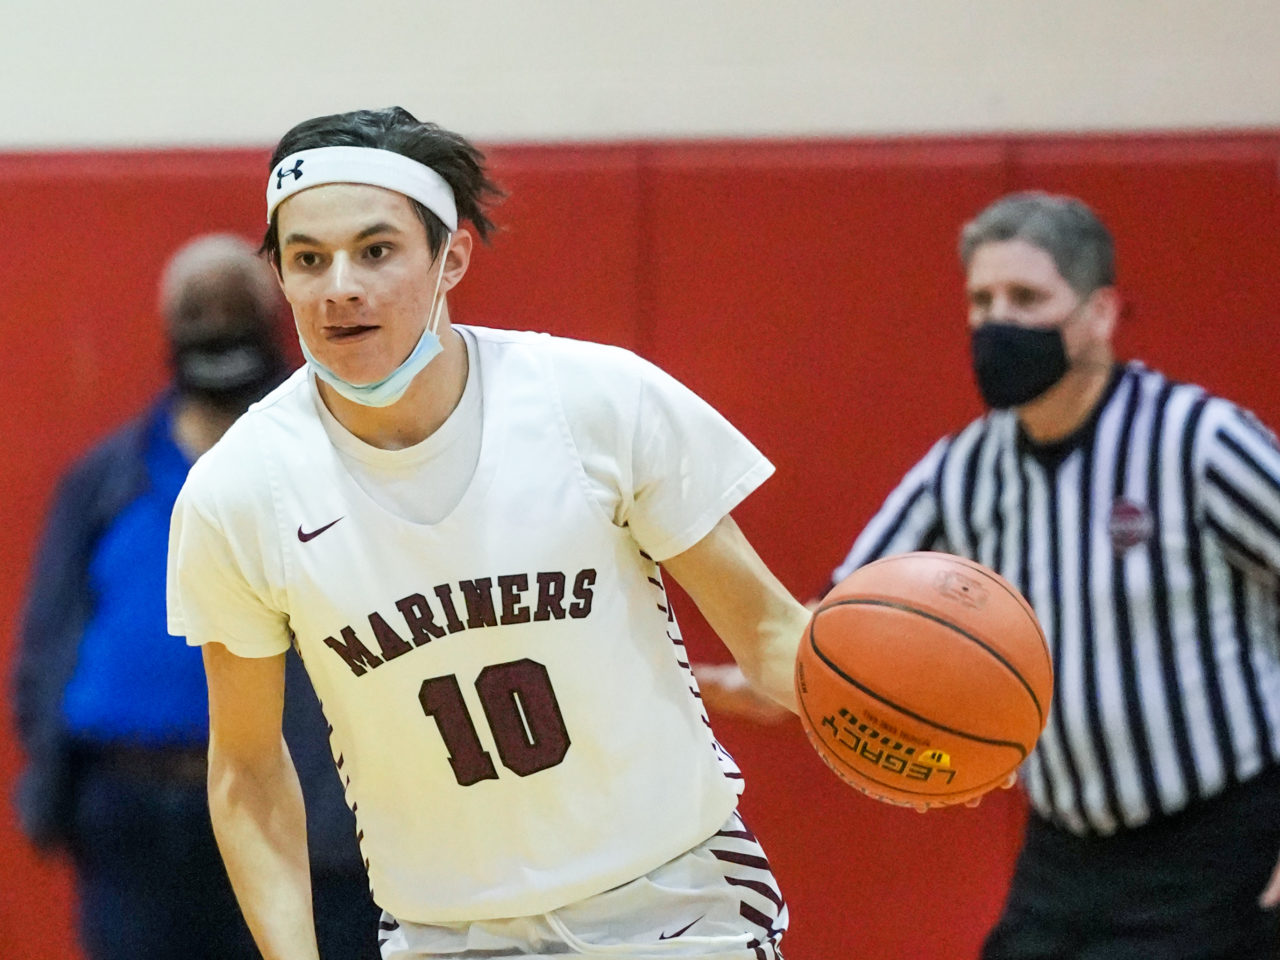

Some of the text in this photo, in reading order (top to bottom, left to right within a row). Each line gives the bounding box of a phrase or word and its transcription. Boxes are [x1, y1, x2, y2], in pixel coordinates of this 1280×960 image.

[323, 568, 597, 677] MARINERS
[418, 658, 572, 787] 10
[821, 714, 957, 785] LEGACY
